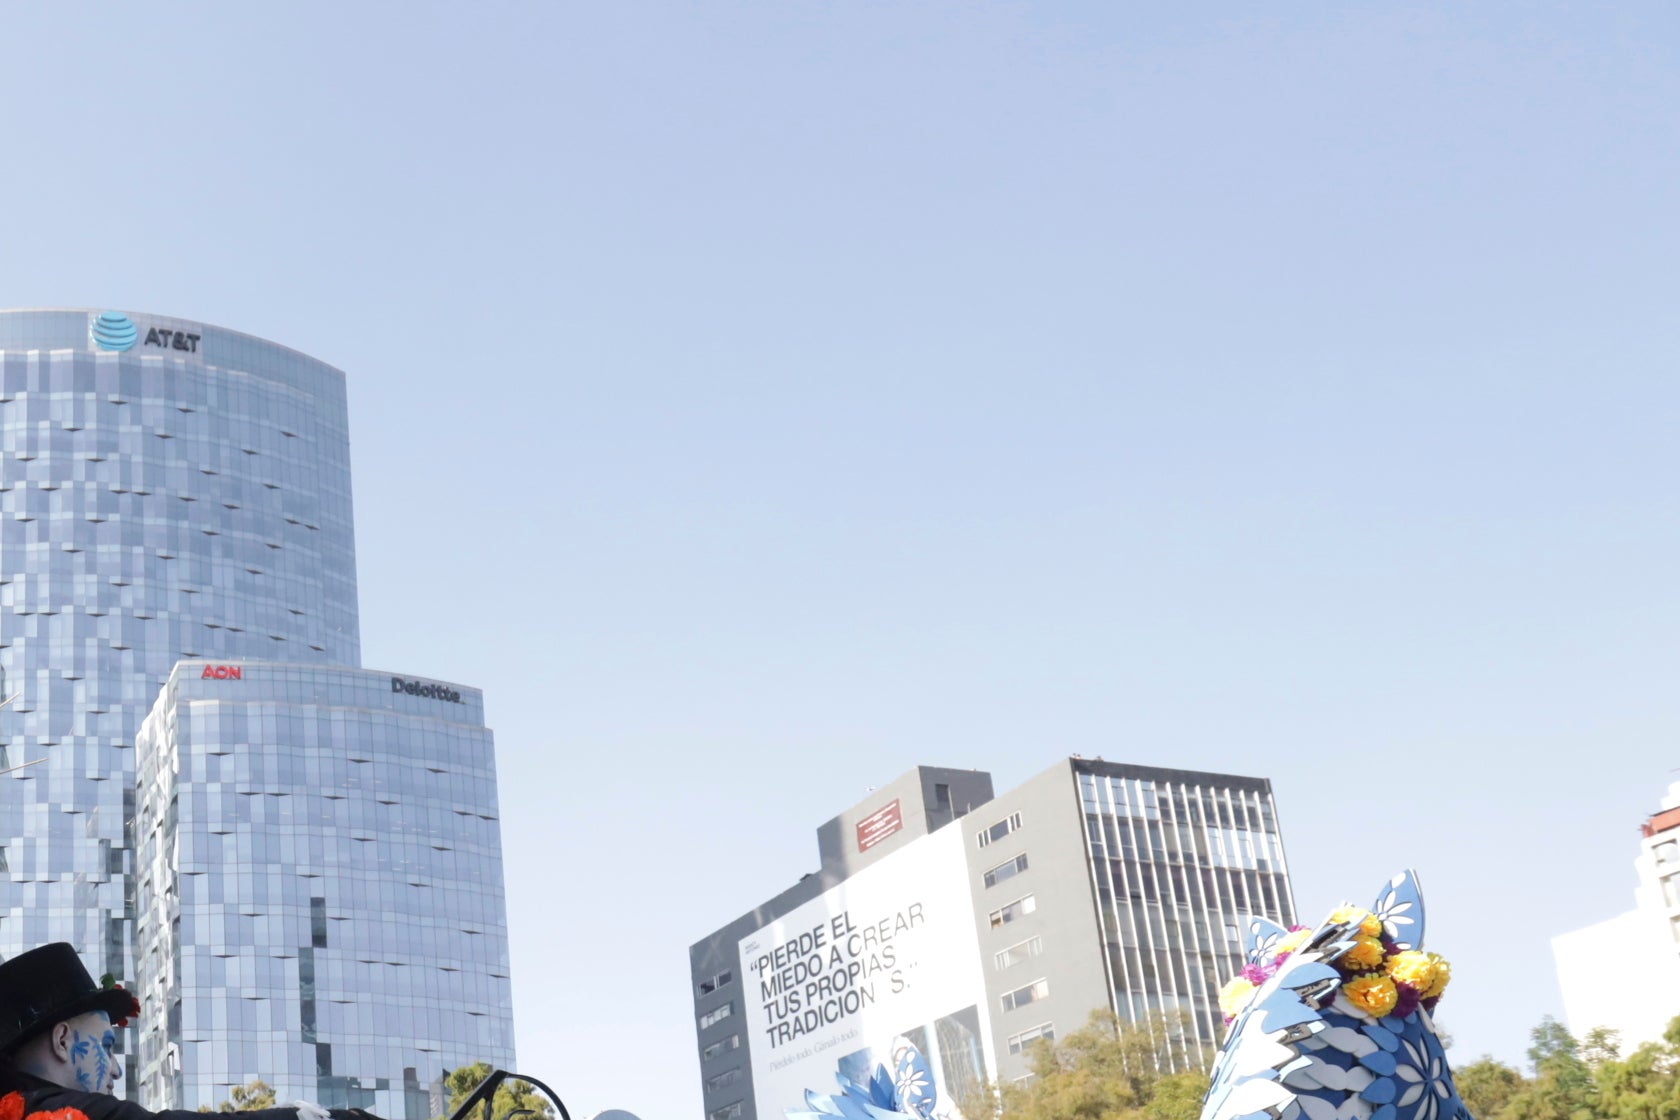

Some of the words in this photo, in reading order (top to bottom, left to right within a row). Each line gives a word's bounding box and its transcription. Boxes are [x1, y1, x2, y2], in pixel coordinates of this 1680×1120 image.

[143, 326, 201, 353] AT&T
[200, 663, 242, 680] AON
[831, 910, 857, 941] EL
[760, 953, 823, 1002] MIEDO
[829, 944, 844, 970] A
[847, 901, 925, 958] CREAR
[763, 990, 801, 1025] TUS
[805, 945, 896, 1007] PROPIAS
